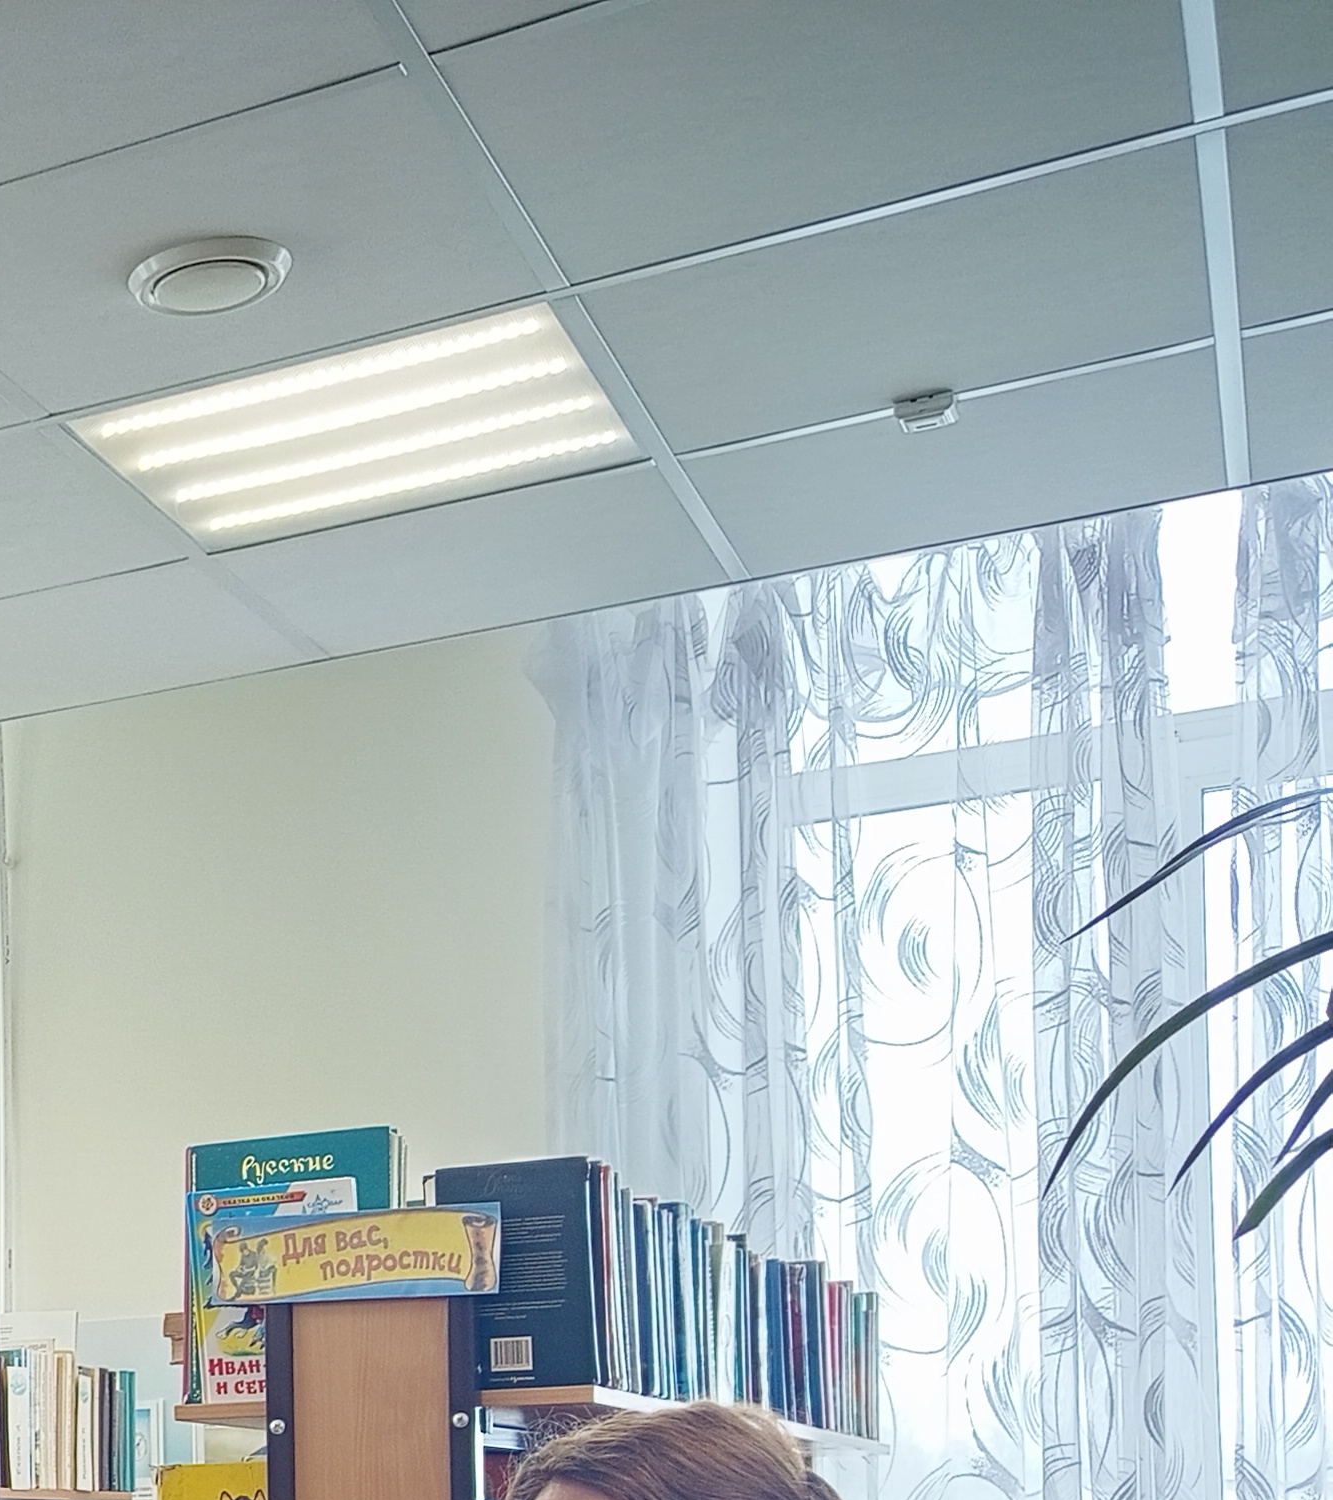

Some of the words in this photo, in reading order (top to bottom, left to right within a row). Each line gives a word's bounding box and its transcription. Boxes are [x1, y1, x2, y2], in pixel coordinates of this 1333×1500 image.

[241, 1153, 336, 1183] Русские
[282, 1231, 329, 1267] Для
[335, 1223, 390, 1251] вас,
[319, 1250, 463, 1283] подростки
